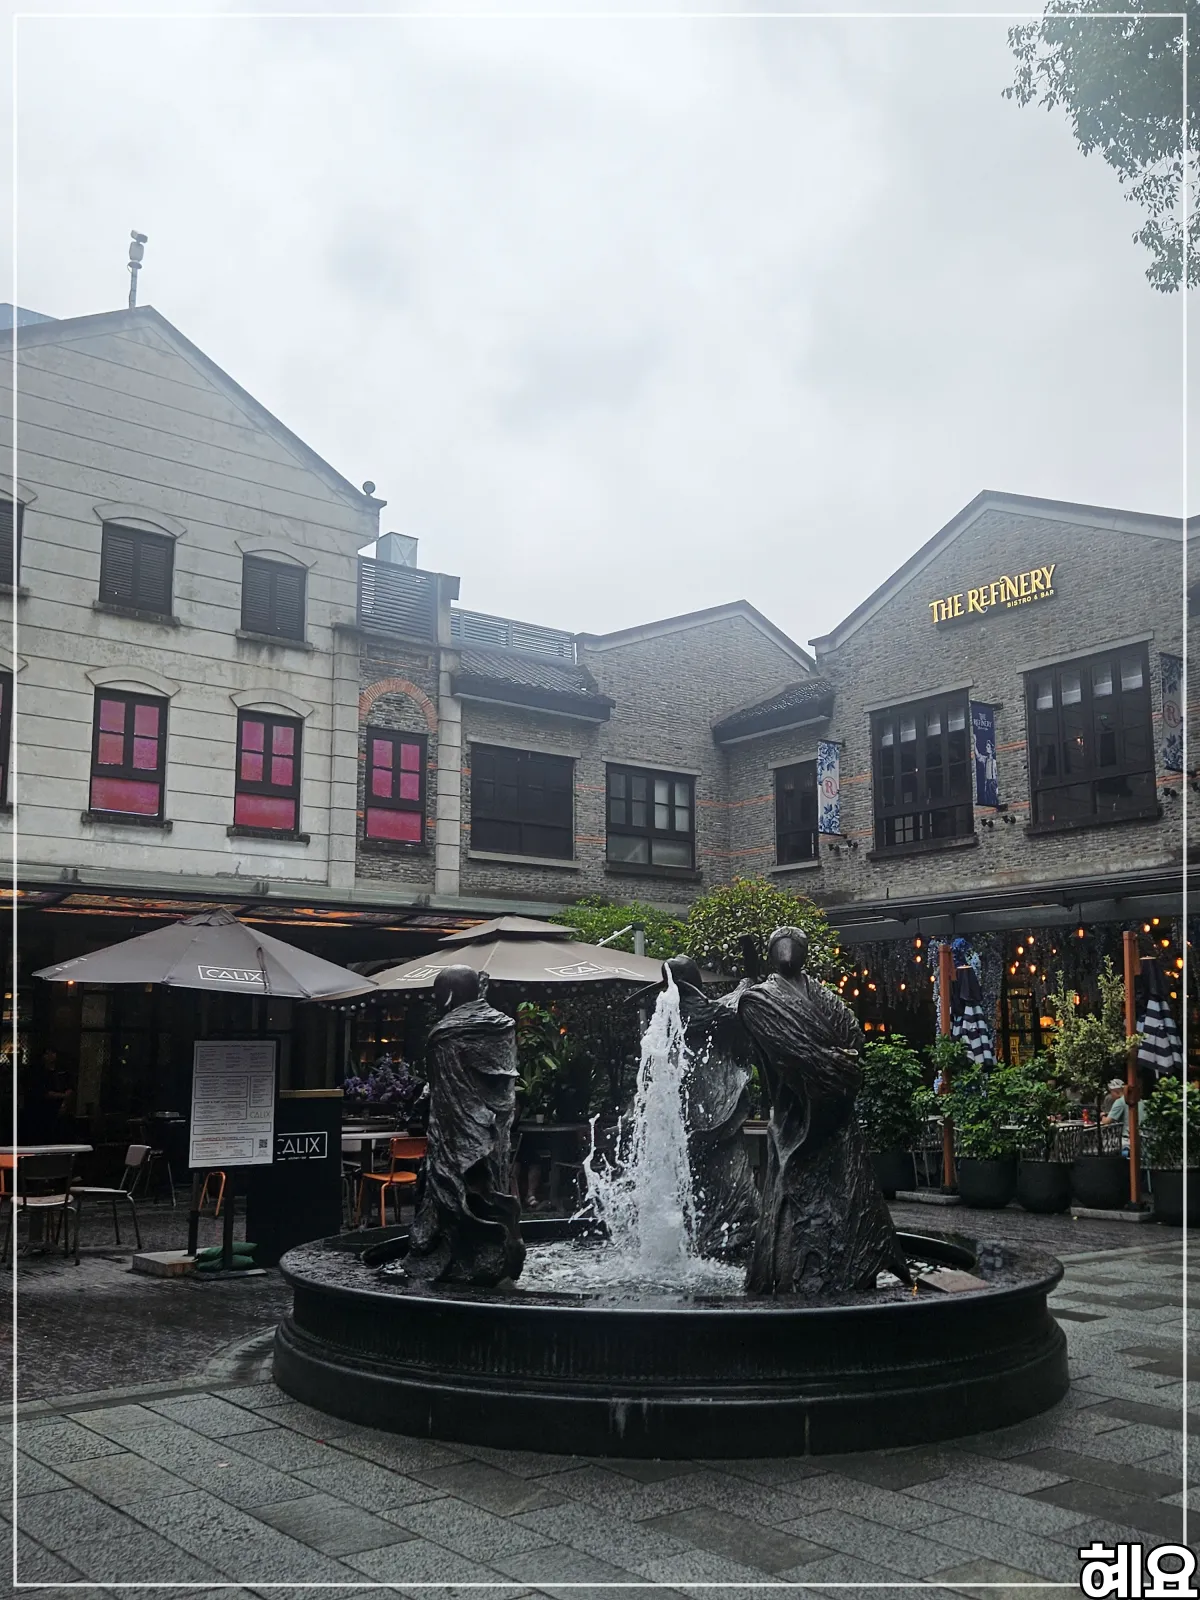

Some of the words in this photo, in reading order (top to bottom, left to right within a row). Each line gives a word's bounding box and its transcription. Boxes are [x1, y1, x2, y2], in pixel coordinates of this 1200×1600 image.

[928, 593, 965, 624] THE
[967, 563, 1056, 614] REFINERY
[1007, 596, 1032, 608] BISTRO
[1040, 589, 1055, 599] BAR
[825, 779, 837, 796] R
[206, 969, 264, 982] CALIX
[249, 1110, 271, 1119] CALIX
